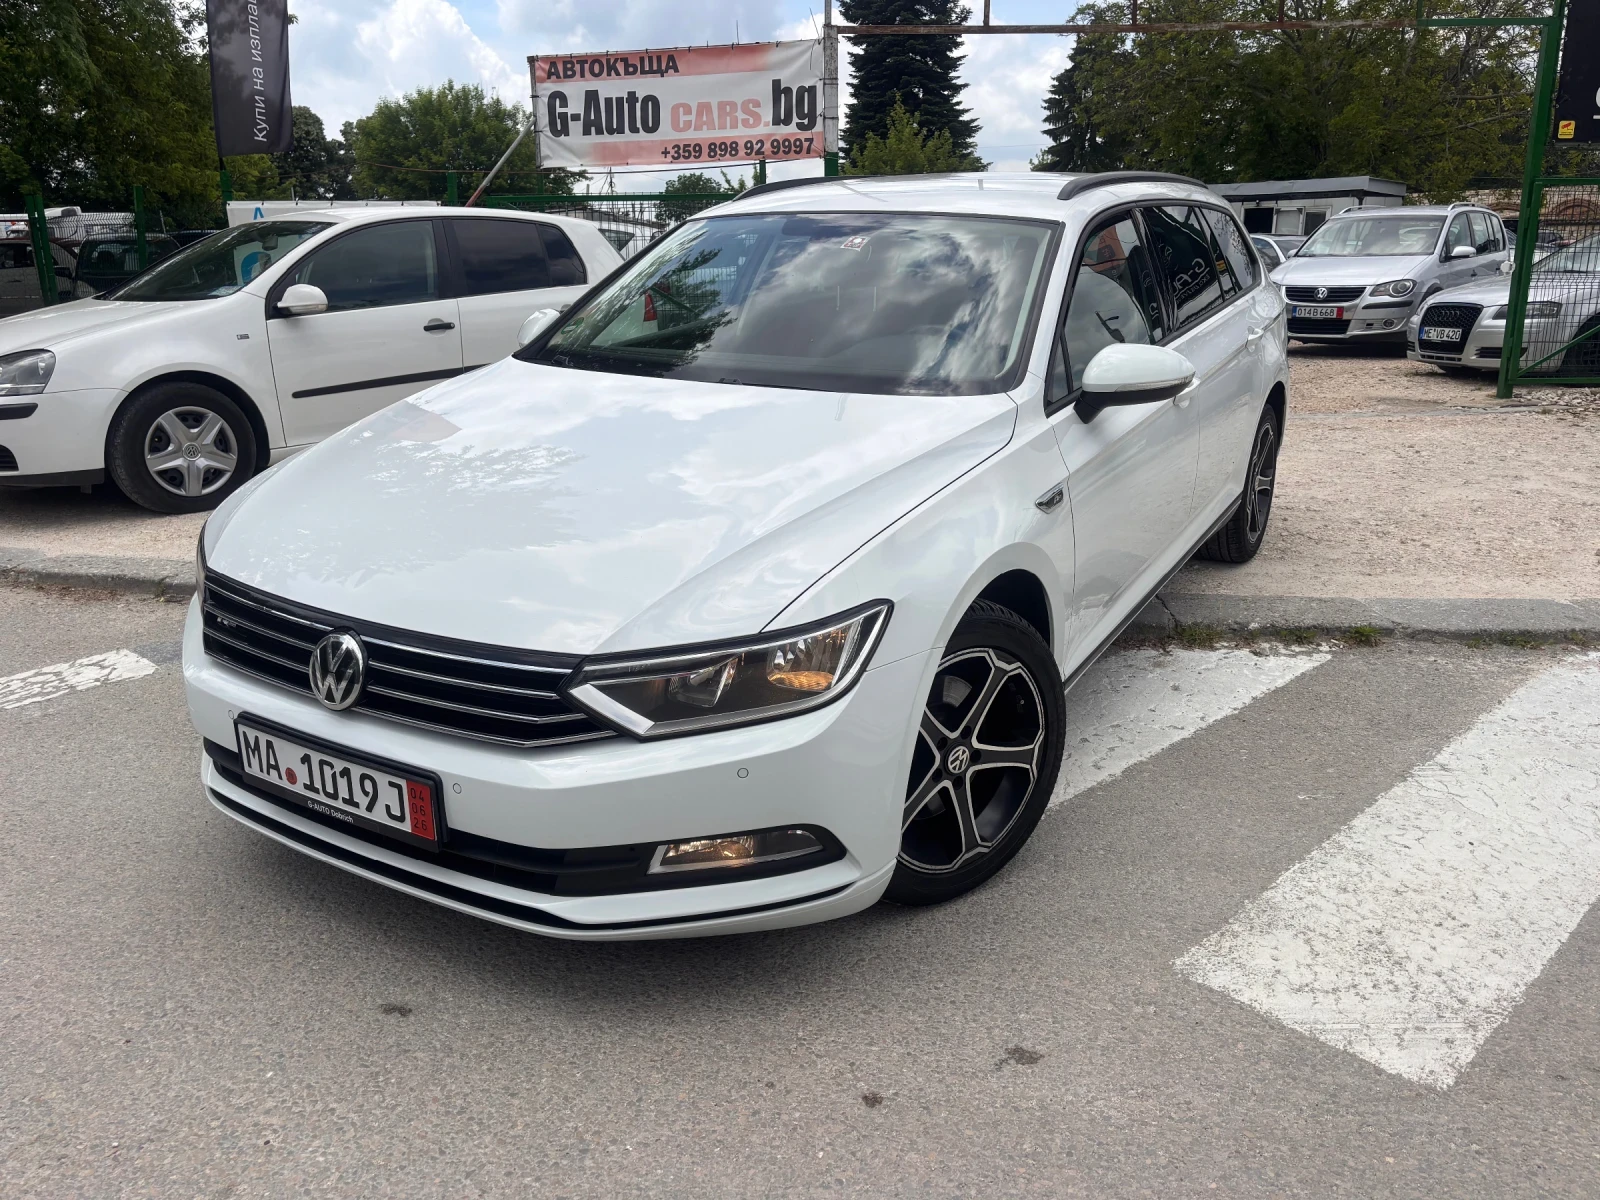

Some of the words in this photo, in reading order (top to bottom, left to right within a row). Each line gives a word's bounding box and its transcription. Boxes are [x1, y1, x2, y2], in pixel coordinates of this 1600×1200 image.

[247, 0, 263, 62] изпла
[252, 67, 265, 91] на
[546, 54, 680, 80] АВТОКЪЩА
[254, 96, 269, 142] Купи
[547, 89, 661, 138] G-Auto
[661, 143, 703, 161] +359
[707, 141, 740, 158] 898
[744, 139, 766, 156] 92
[770, 137, 814, 156] 9997
[1446, 329, 1461, 340] 420
[242, 730, 283, 781] MA
[410, 787, 425, 802] 04
[307, 800, 330, 815] G-AUTO
[330, 809, 354, 824] Dobrich
[411, 801, 426, 816] 06
[413, 816, 428, 831] 26
